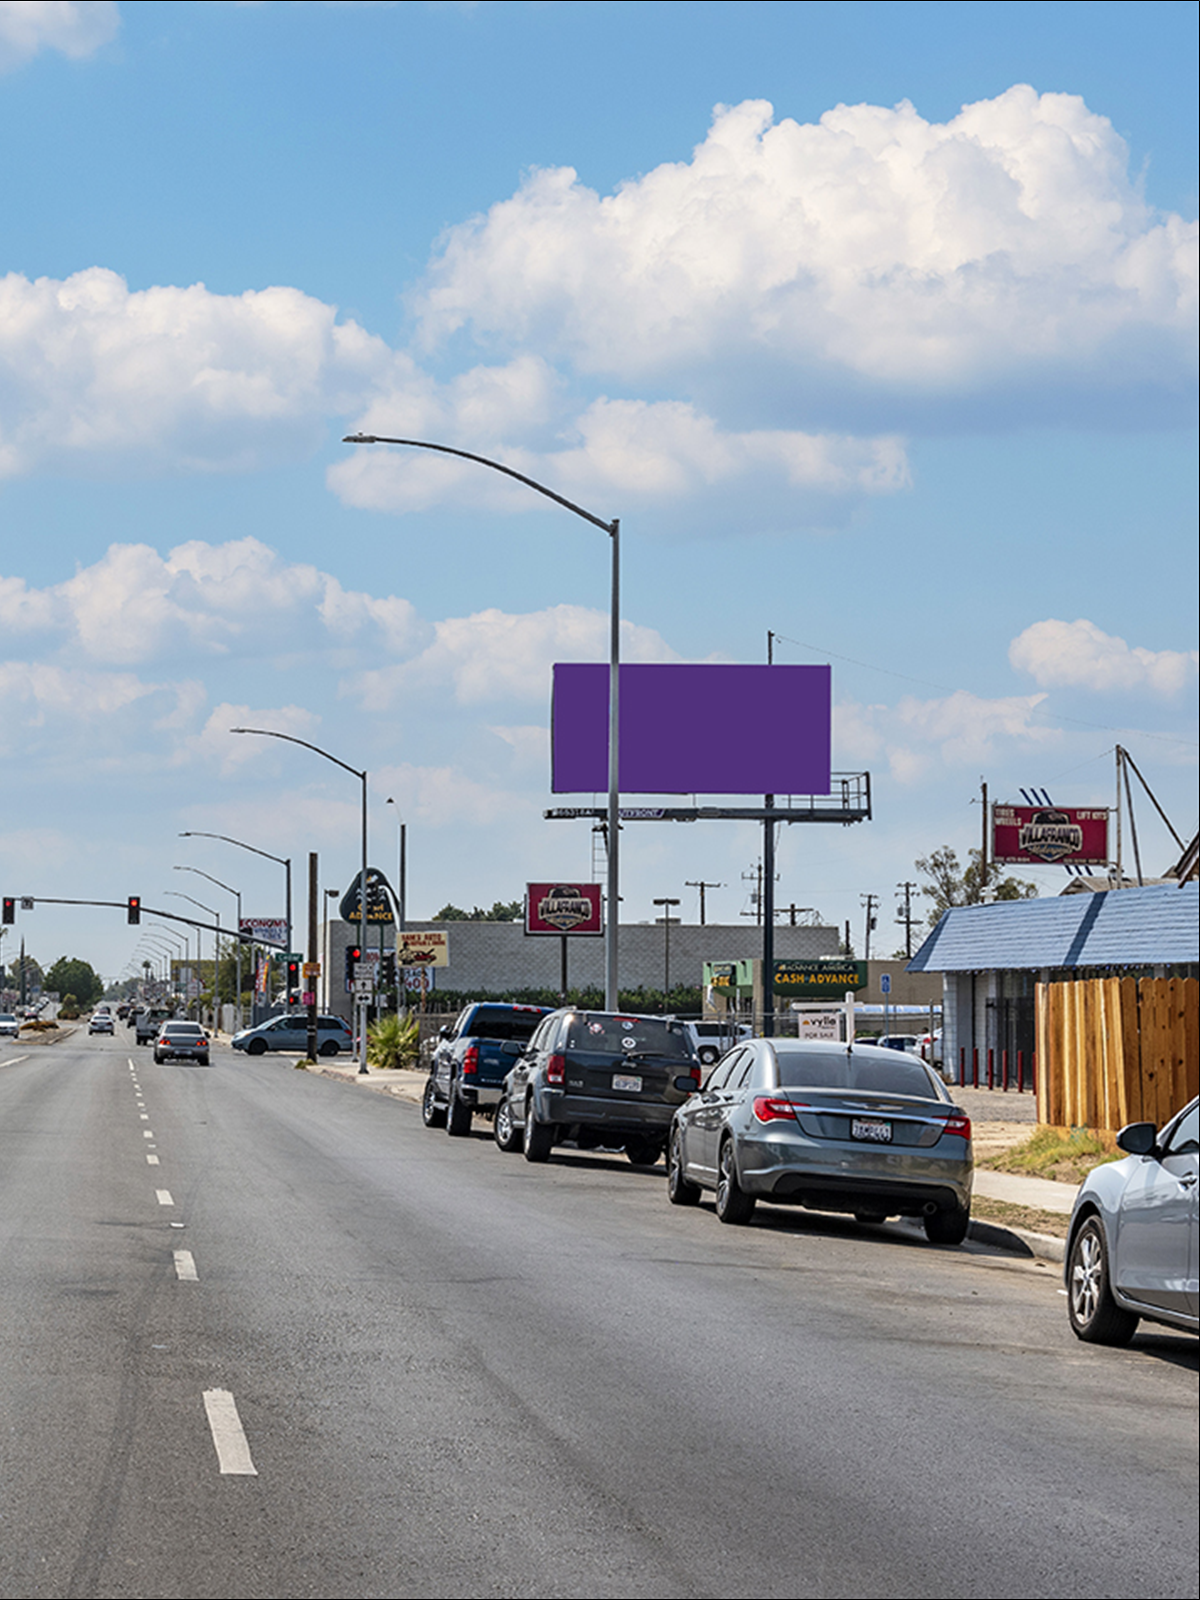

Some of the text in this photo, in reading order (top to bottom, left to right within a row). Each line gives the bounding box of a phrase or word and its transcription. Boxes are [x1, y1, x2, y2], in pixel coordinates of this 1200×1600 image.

[619, 809, 659, 817] UTFRONT
[1022, 826, 1080, 848] VILLAFRANCO
[424, 933, 442, 941] AUTO
[774, 973, 859, 984] CASH ADVANCE
